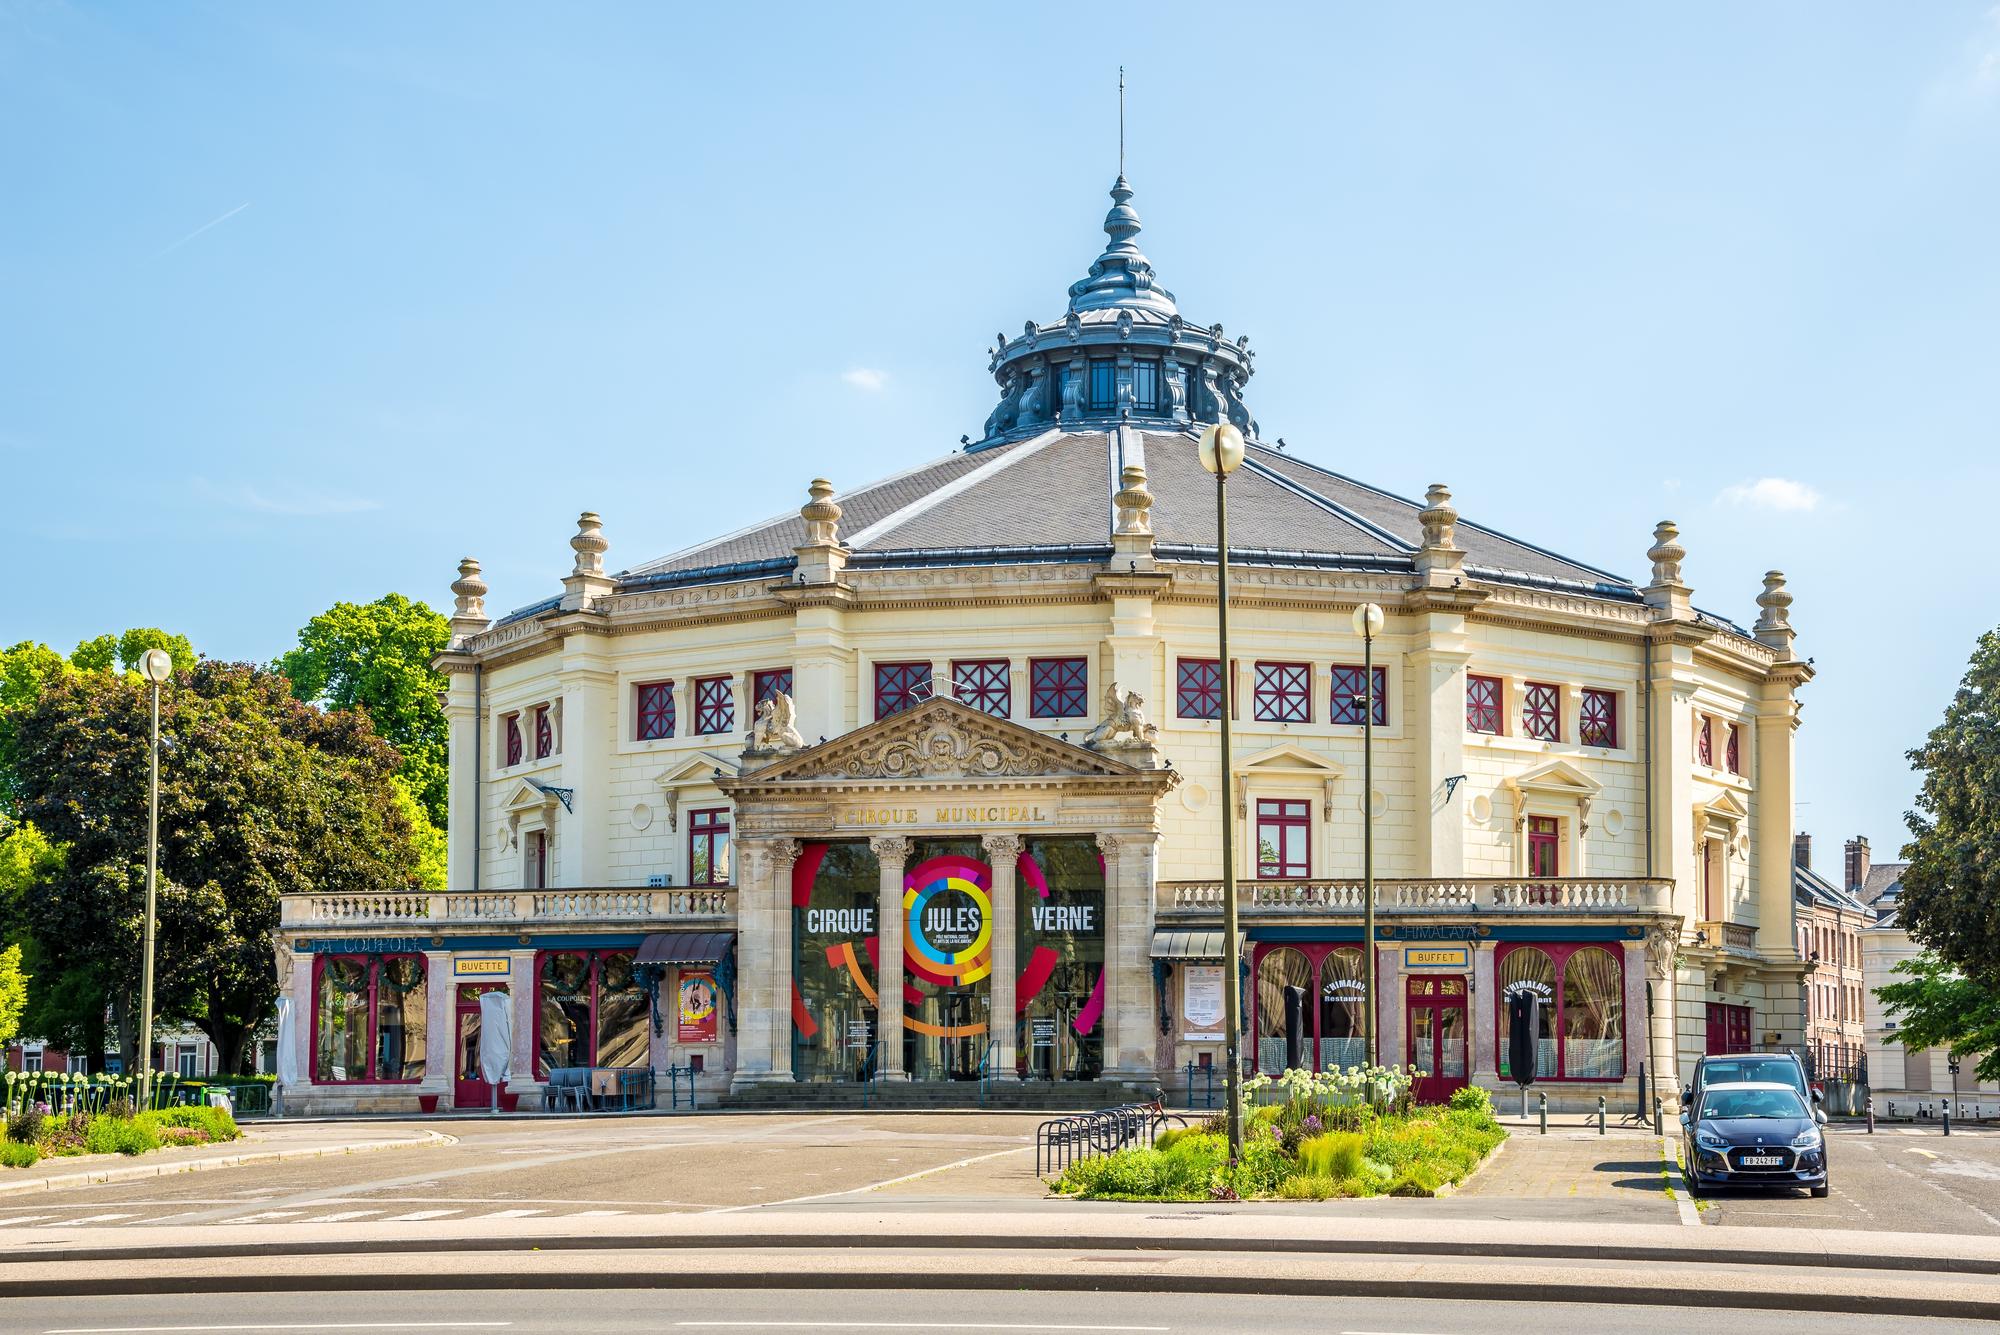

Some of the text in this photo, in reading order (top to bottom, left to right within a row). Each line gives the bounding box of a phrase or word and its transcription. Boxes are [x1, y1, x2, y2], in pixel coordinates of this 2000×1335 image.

[845, 807, 1045, 825] CIRQUE MUNICIPAL
[807, 906, 1094, 934] CIRQUE JULES VERNE
[344, 936, 421, 953] COUPOLE
[1418, 953, 1455, 961] BUFFET
[461, 960, 503, 971] BUVETTE
[1323, 979, 1366, 994] L'HIMALAY
[1503, 980, 1552, 996] L'HIMALAYA
